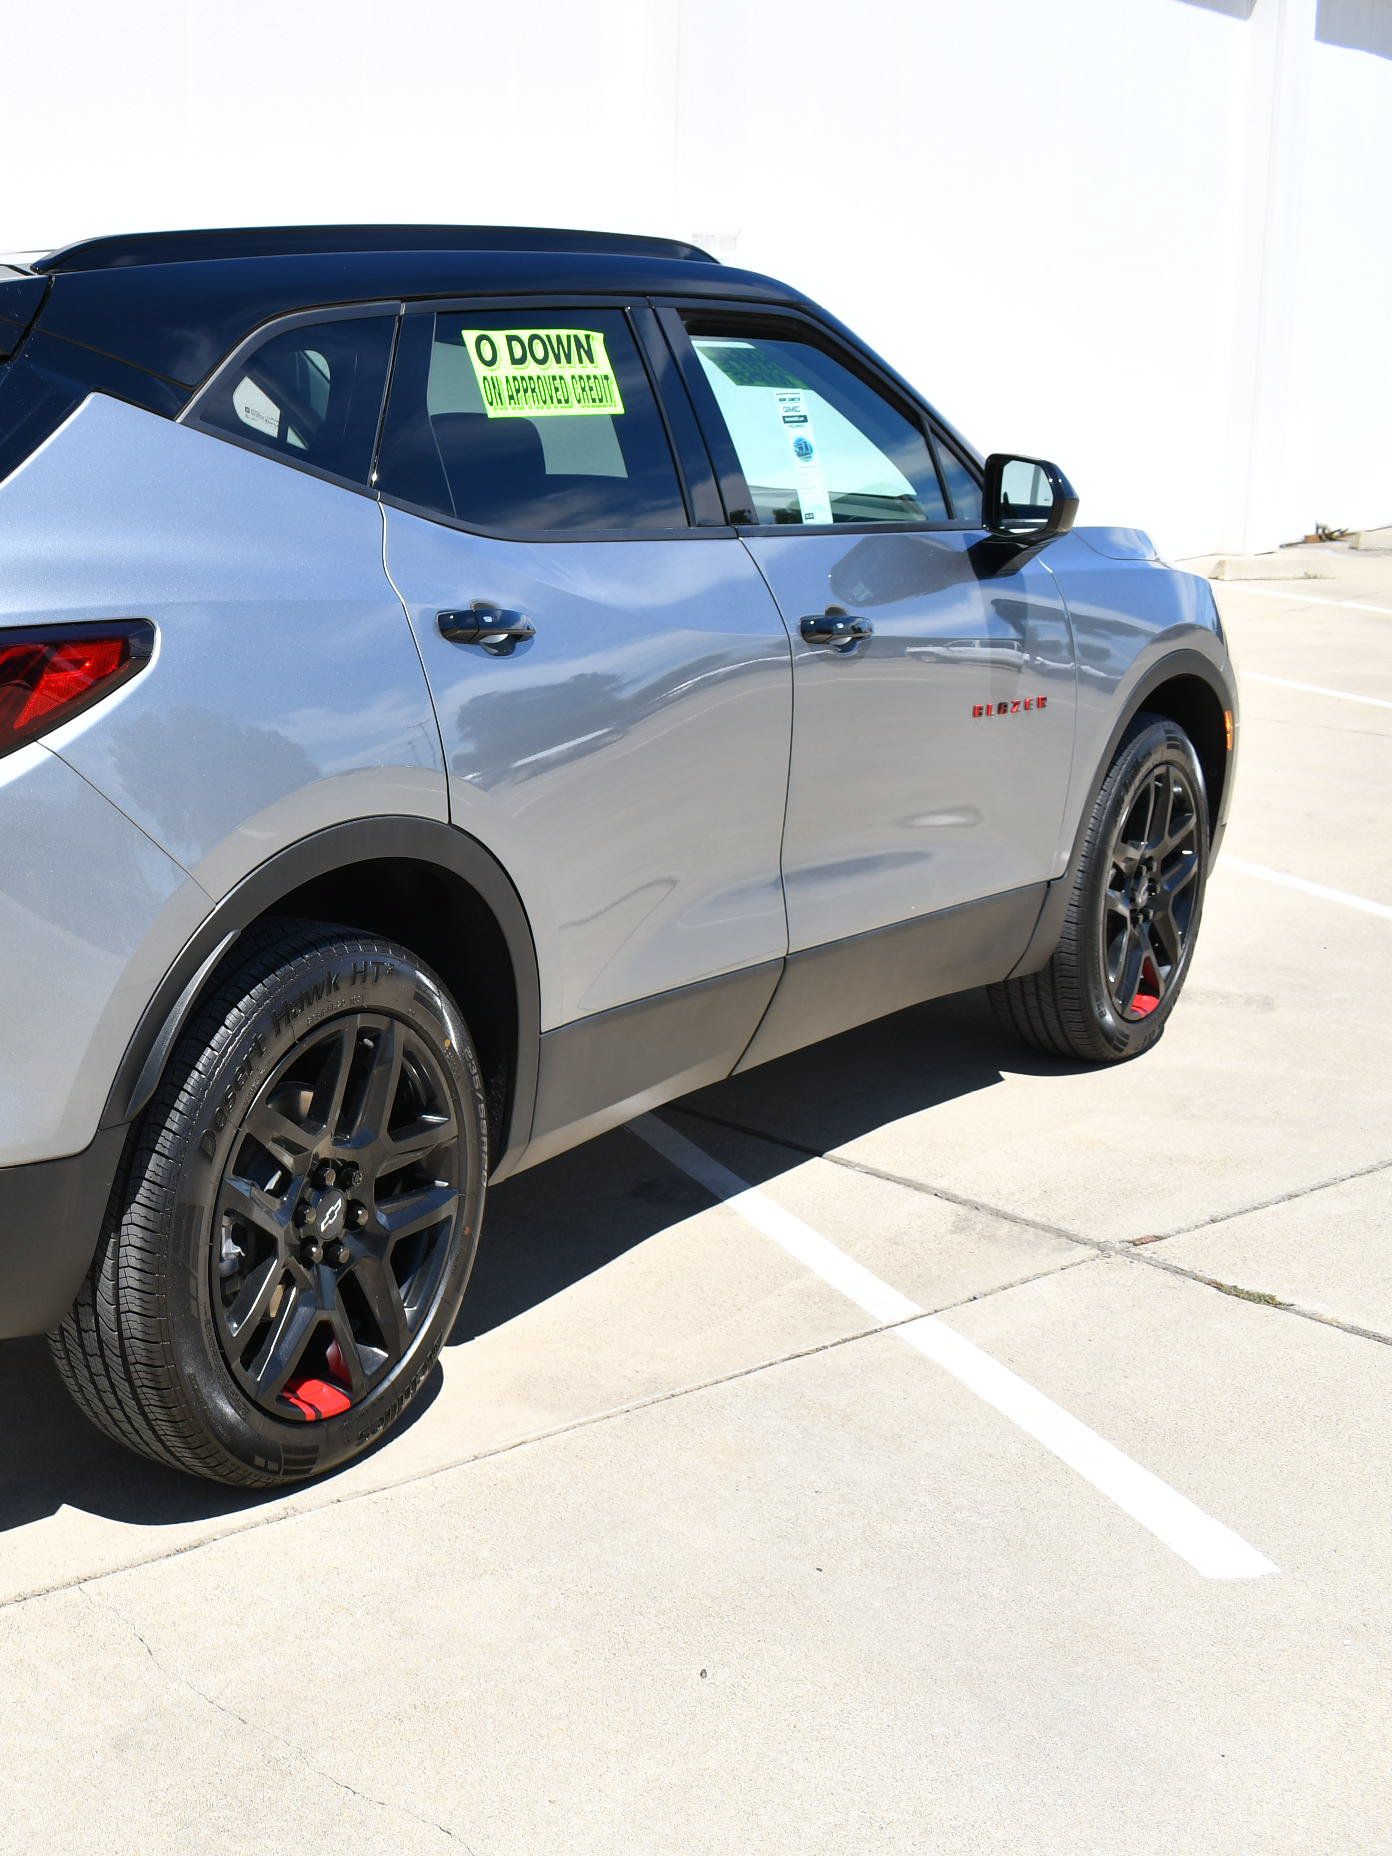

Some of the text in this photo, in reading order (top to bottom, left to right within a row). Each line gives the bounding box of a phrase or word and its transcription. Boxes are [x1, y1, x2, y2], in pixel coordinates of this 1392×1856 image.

[505, 333, 596, 366] DOWN
[482, 374, 613, 407] ON APPROVED CREDIT
